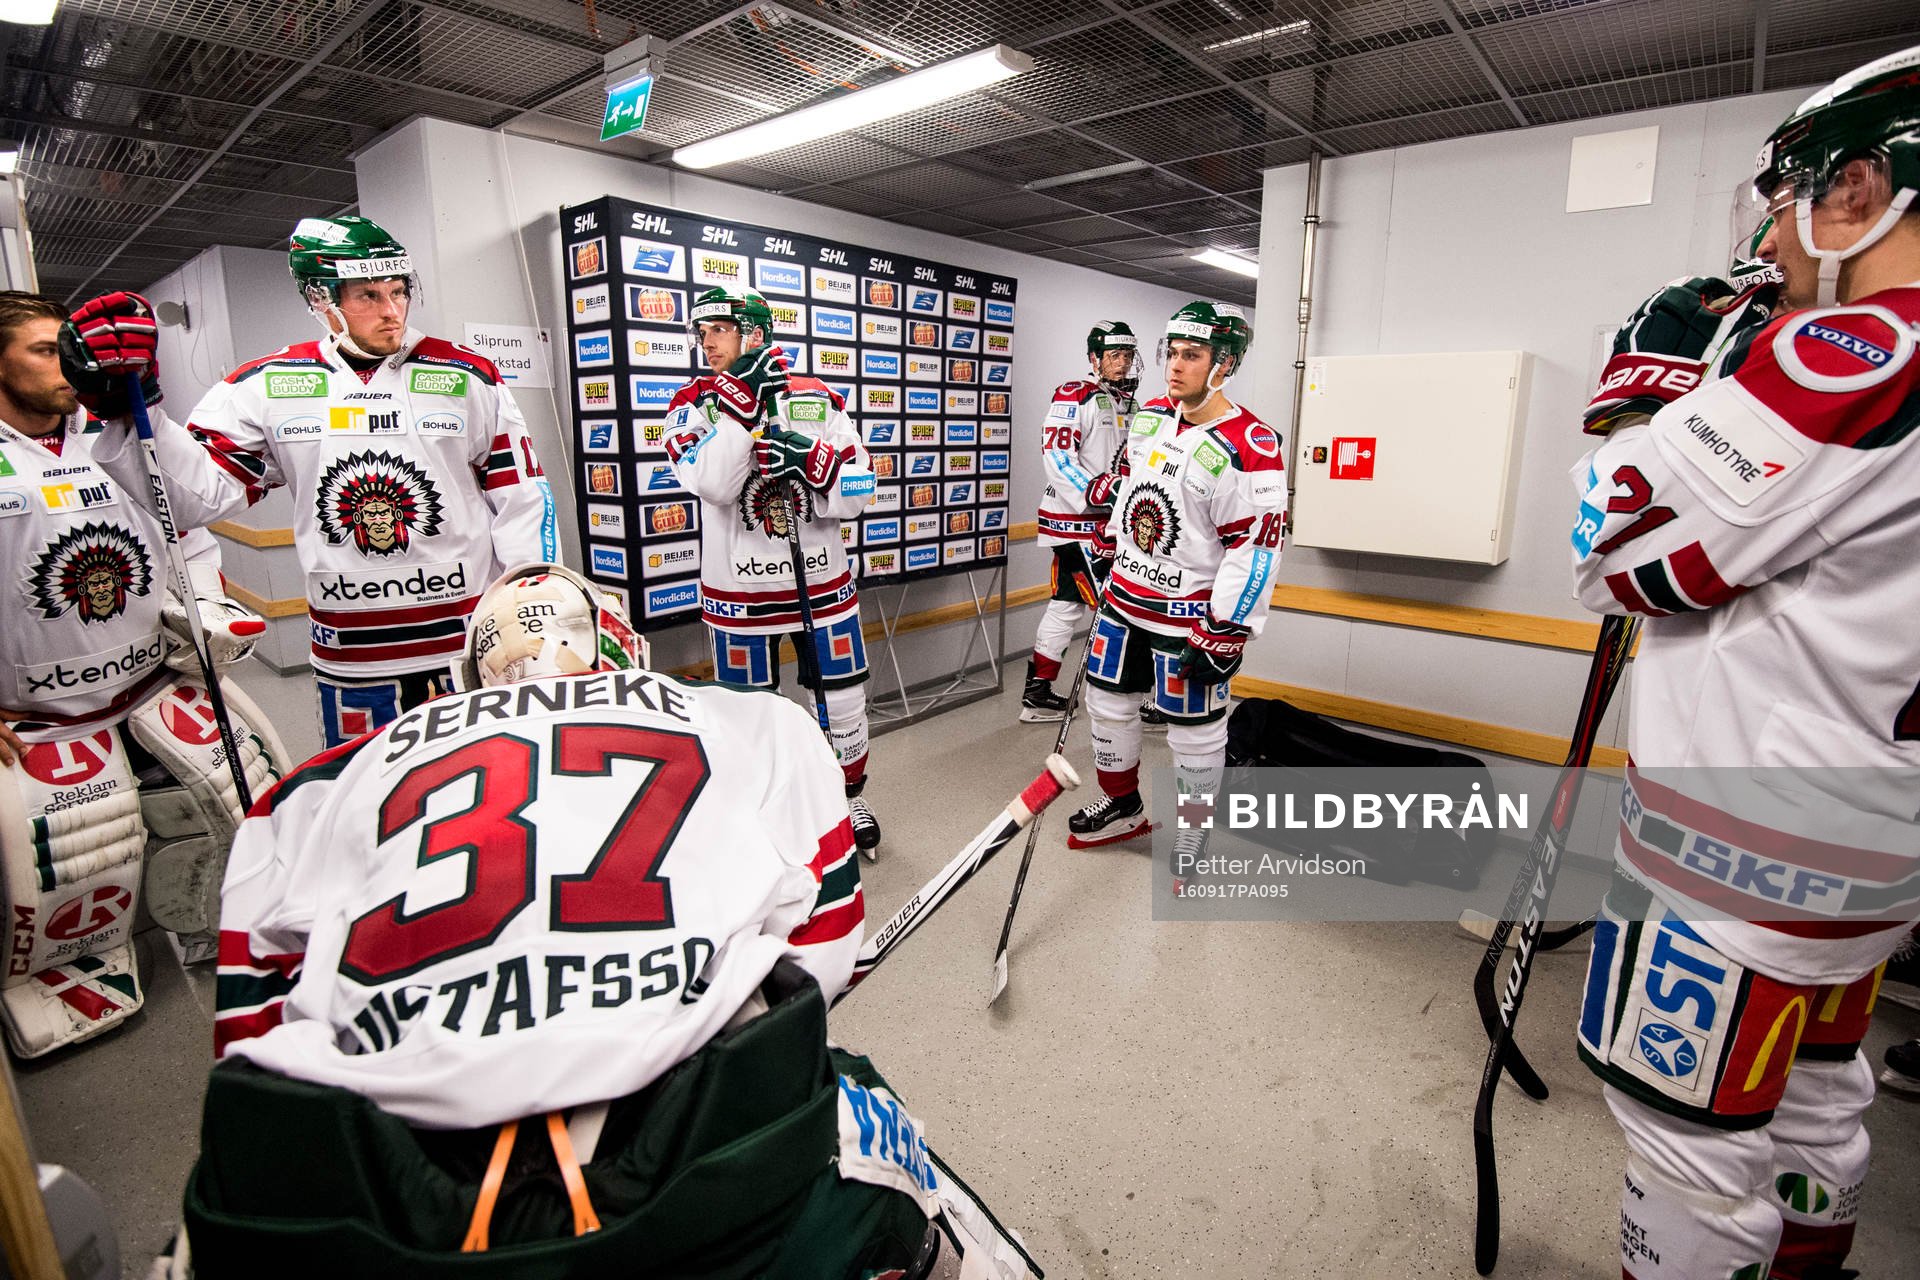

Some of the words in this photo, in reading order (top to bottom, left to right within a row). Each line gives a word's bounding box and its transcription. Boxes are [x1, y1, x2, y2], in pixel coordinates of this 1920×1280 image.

[574, 212, 598, 234] SHL
[632, 212, 672, 235] SHL
[702, 226, 738, 247] SHL
[764, 236, 796, 256] SHL
[578, 255, 598, 272] GULD
[819, 248, 848, 266] SHL
[703, 258, 738, 276] SPORT
[868, 258, 896, 274] SHL
[762, 271, 800, 286] NordicBet
[914, 267, 938, 282] SHL
[1731, 267, 1785, 292] URFORS
[828, 280, 852, 290] BEIJER
[954, 275, 976, 290] SHL
[991, 282, 1012, 296] SHL
[586, 296, 606, 306] BEIJER
[952, 298, 976, 311] SPORT
[640, 302, 674, 315] GULD
[772, 308, 798, 322] PORT
[988, 308, 1012, 318] NordicBet
[818, 317, 851, 330] NordicBet
[876, 324, 898, 332] BEIJER
[473, 334, 522, 350] Sliprum
[652, 342, 684, 352] BEIJER
[988, 334, 1009, 347] SPORT
[1807, 325, 1886, 364] VOLVO
[580, 342, 608, 356] NordicBet
[490, 357, 531, 370] rkstad
[820, 351, 850, 366] SPORT
[866, 360, 897, 370] NordicBet
[919, 362, 938, 370] BEIJER
[272, 377, 305, 386] CASH
[417, 374, 447, 383] CASH
[273, 385, 316, 394] BUDDY
[416, 382, 454, 392] BUDDY
[585, 382, 609, 399] SPORT
[640, 388, 675, 398] NordicB
[344, 392, 392, 400] BAUER
[868, 390, 894, 403] SPORT
[910, 396, 937, 405] NordicBet
[794, 404, 813, 412] CASH
[284, 425, 322, 435] BOHUS
[422, 421, 458, 431] BOHUS
[912, 424, 935, 436] SPORT
[644, 426, 664, 442] SPO
[948, 430, 973, 438] NordicBet
[1044, 426, 1072, 450] 78
[876, 462, 893, 474] ULD
[950, 456, 972, 467] SPORT
[42, 466, 92, 478] BAUER
[593, 475, 614, 489] GULD
[842, 480, 876, 492] EHRENB
[984, 484, 1004, 494] SPORT
[1095, 473, 1114, 501] BAU
[876, 493, 897, 501] BEIJER
[0, 500, 20, 510] HUS
[150, 474, 178, 544] EASTON
[545, 482, 555, 562] HRENBORG
[600, 514, 620, 524] BEIJER
[654, 514, 686, 530] GULD
[784, 500, 798, 544] BAUER
[918, 520, 936, 528] BEIJER
[1050, 521, 1072, 531] SKF
[868, 527, 896, 536] NordicBet
[1254, 512, 1281, 548] 18
[595, 556, 622, 568] NordicBet
[664, 550, 694, 561] BEIJER
[736, 546, 828, 576] xtened
[869, 554, 895, 567] SPORT
[910, 553, 936, 562] NordicBet
[1114, 550, 1182, 589] xtended
[320, 562, 466, 601] xtended
[416, 592, 444, 602] Business
[451, 589, 466, 598] Event
[652, 590, 695, 606] NordicBet
[840, 582, 856, 601] SK
[704, 600, 746, 616] SKF
[1170, 601, 1209, 617] SK
[27, 633, 162, 693] xtended
[504, 660, 525, 680] 37
[385, 674, 691, 763] SERNEKE
[844, 752, 862, 762] PARK
[52, 779, 118, 805] Reklam
[1621, 778, 1642, 827] KF
[338, 722, 712, 986] 37
[1684, 835, 1846, 906] SKF
[876, 895, 922, 950] BAUER
[1500, 832, 1558, 1028] EASTON
[8, 905, 36, 978] CCM
[1621, 1209, 1648, 1240] ANKT
